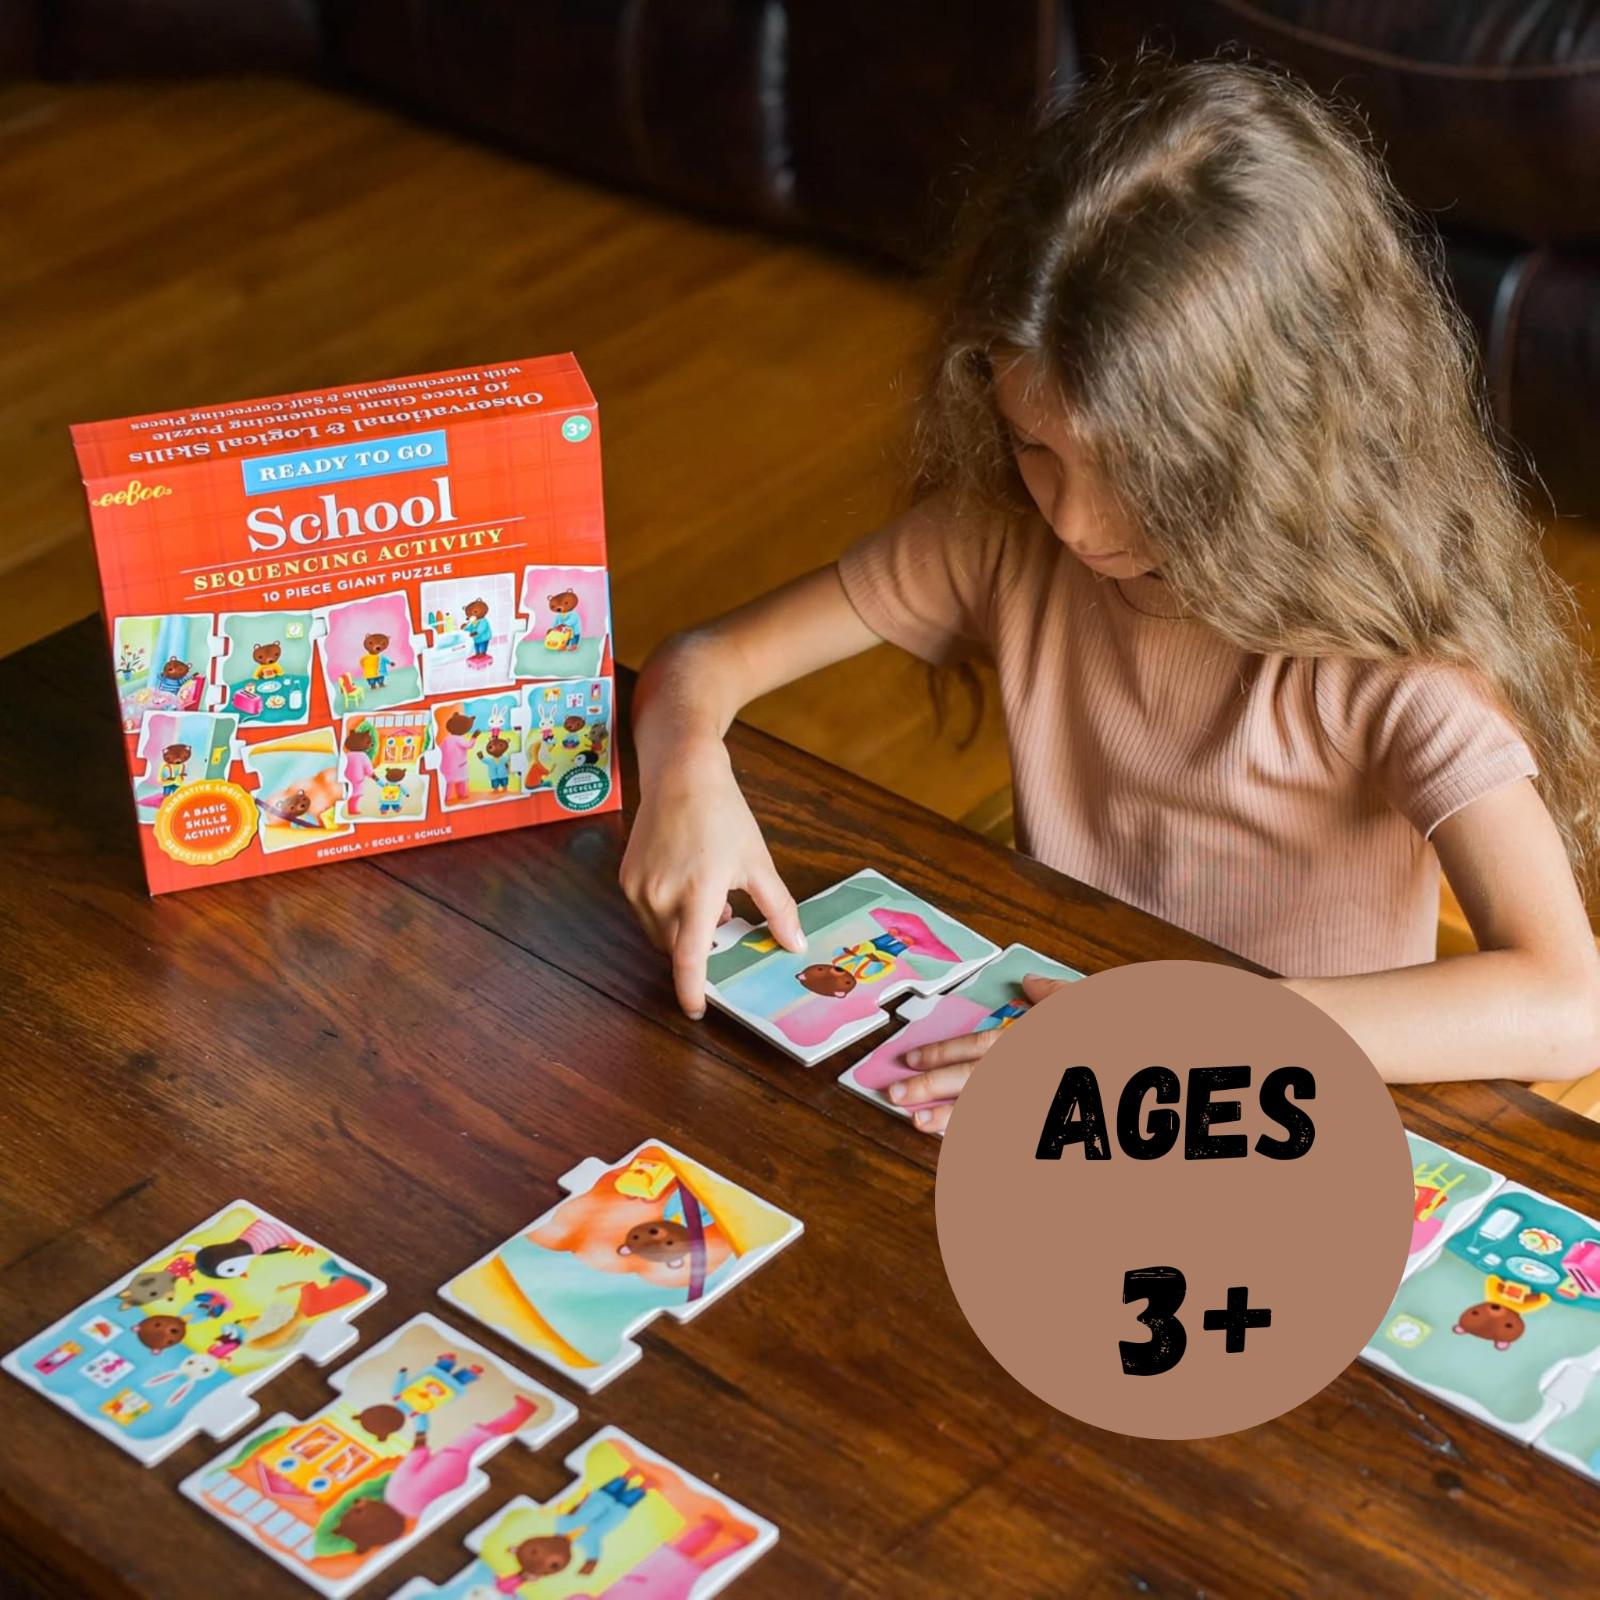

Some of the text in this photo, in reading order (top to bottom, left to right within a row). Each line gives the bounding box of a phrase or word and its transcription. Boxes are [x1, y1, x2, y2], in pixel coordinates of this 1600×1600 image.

[130, 366, 521, 431] with Interchangeable & Self-Correcting Pieces
[152, 381, 509, 442] 10 Piece Giant Sequencing Puzzle
[128, 392, 544, 464] Observational & Logical Skills
[566, 423, 588, 437] 3+
[260, 443, 433, 482] READY TO GO
[246, 477, 457, 552] School
[193, 528, 504, 592] SEQUENCING ACTIVITY
[262, 563, 453, 603] 10 PIECE GIANT PUZZLE
[563, 782, 603, 794] RECYCLED
[183, 803, 227, 819] A BASIC
[186, 814, 227, 829] SKILLS
[184, 825, 231, 841] ACTIVITY
[317, 826, 452, 858] ESCUELA ECOLE SCHULE
